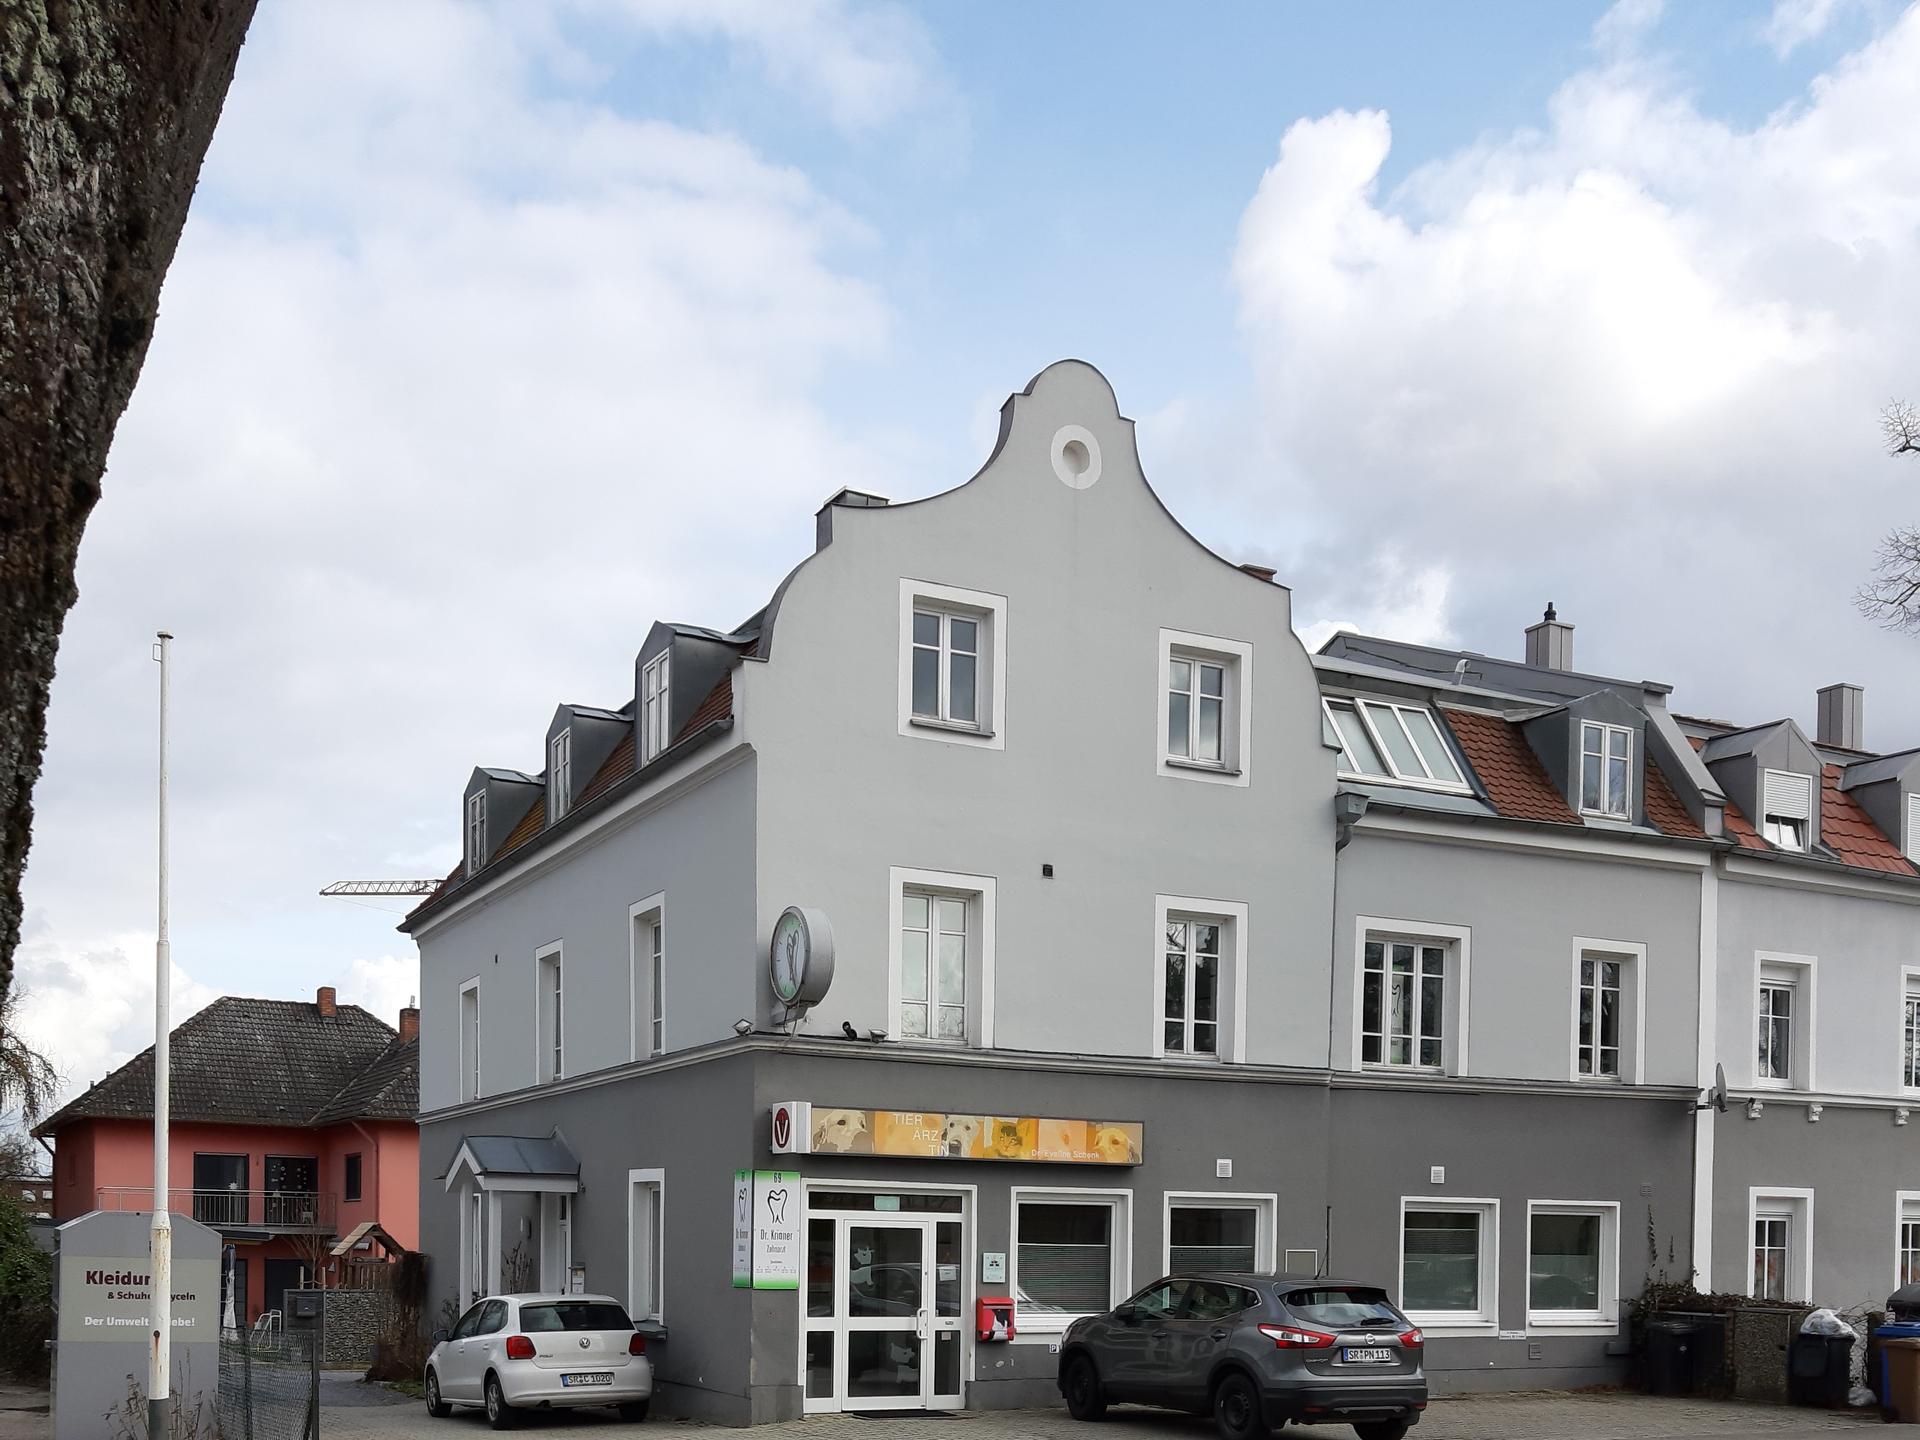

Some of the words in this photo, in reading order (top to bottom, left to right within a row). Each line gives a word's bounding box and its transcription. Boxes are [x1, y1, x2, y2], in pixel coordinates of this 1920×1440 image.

[892, 1113, 923, 1126] TIER
[928, 1144, 950, 1157] TIN
[773, 1172, 782, 1184] 69
[760, 1229, 769, 1241] Dr.
[84, 1316, 104, 1327] Der
[107, 1316, 150, 1327] Umwelt
[1375, 1350, 1390, 1360] 113
[591, 1374, 611, 1383] 1020
